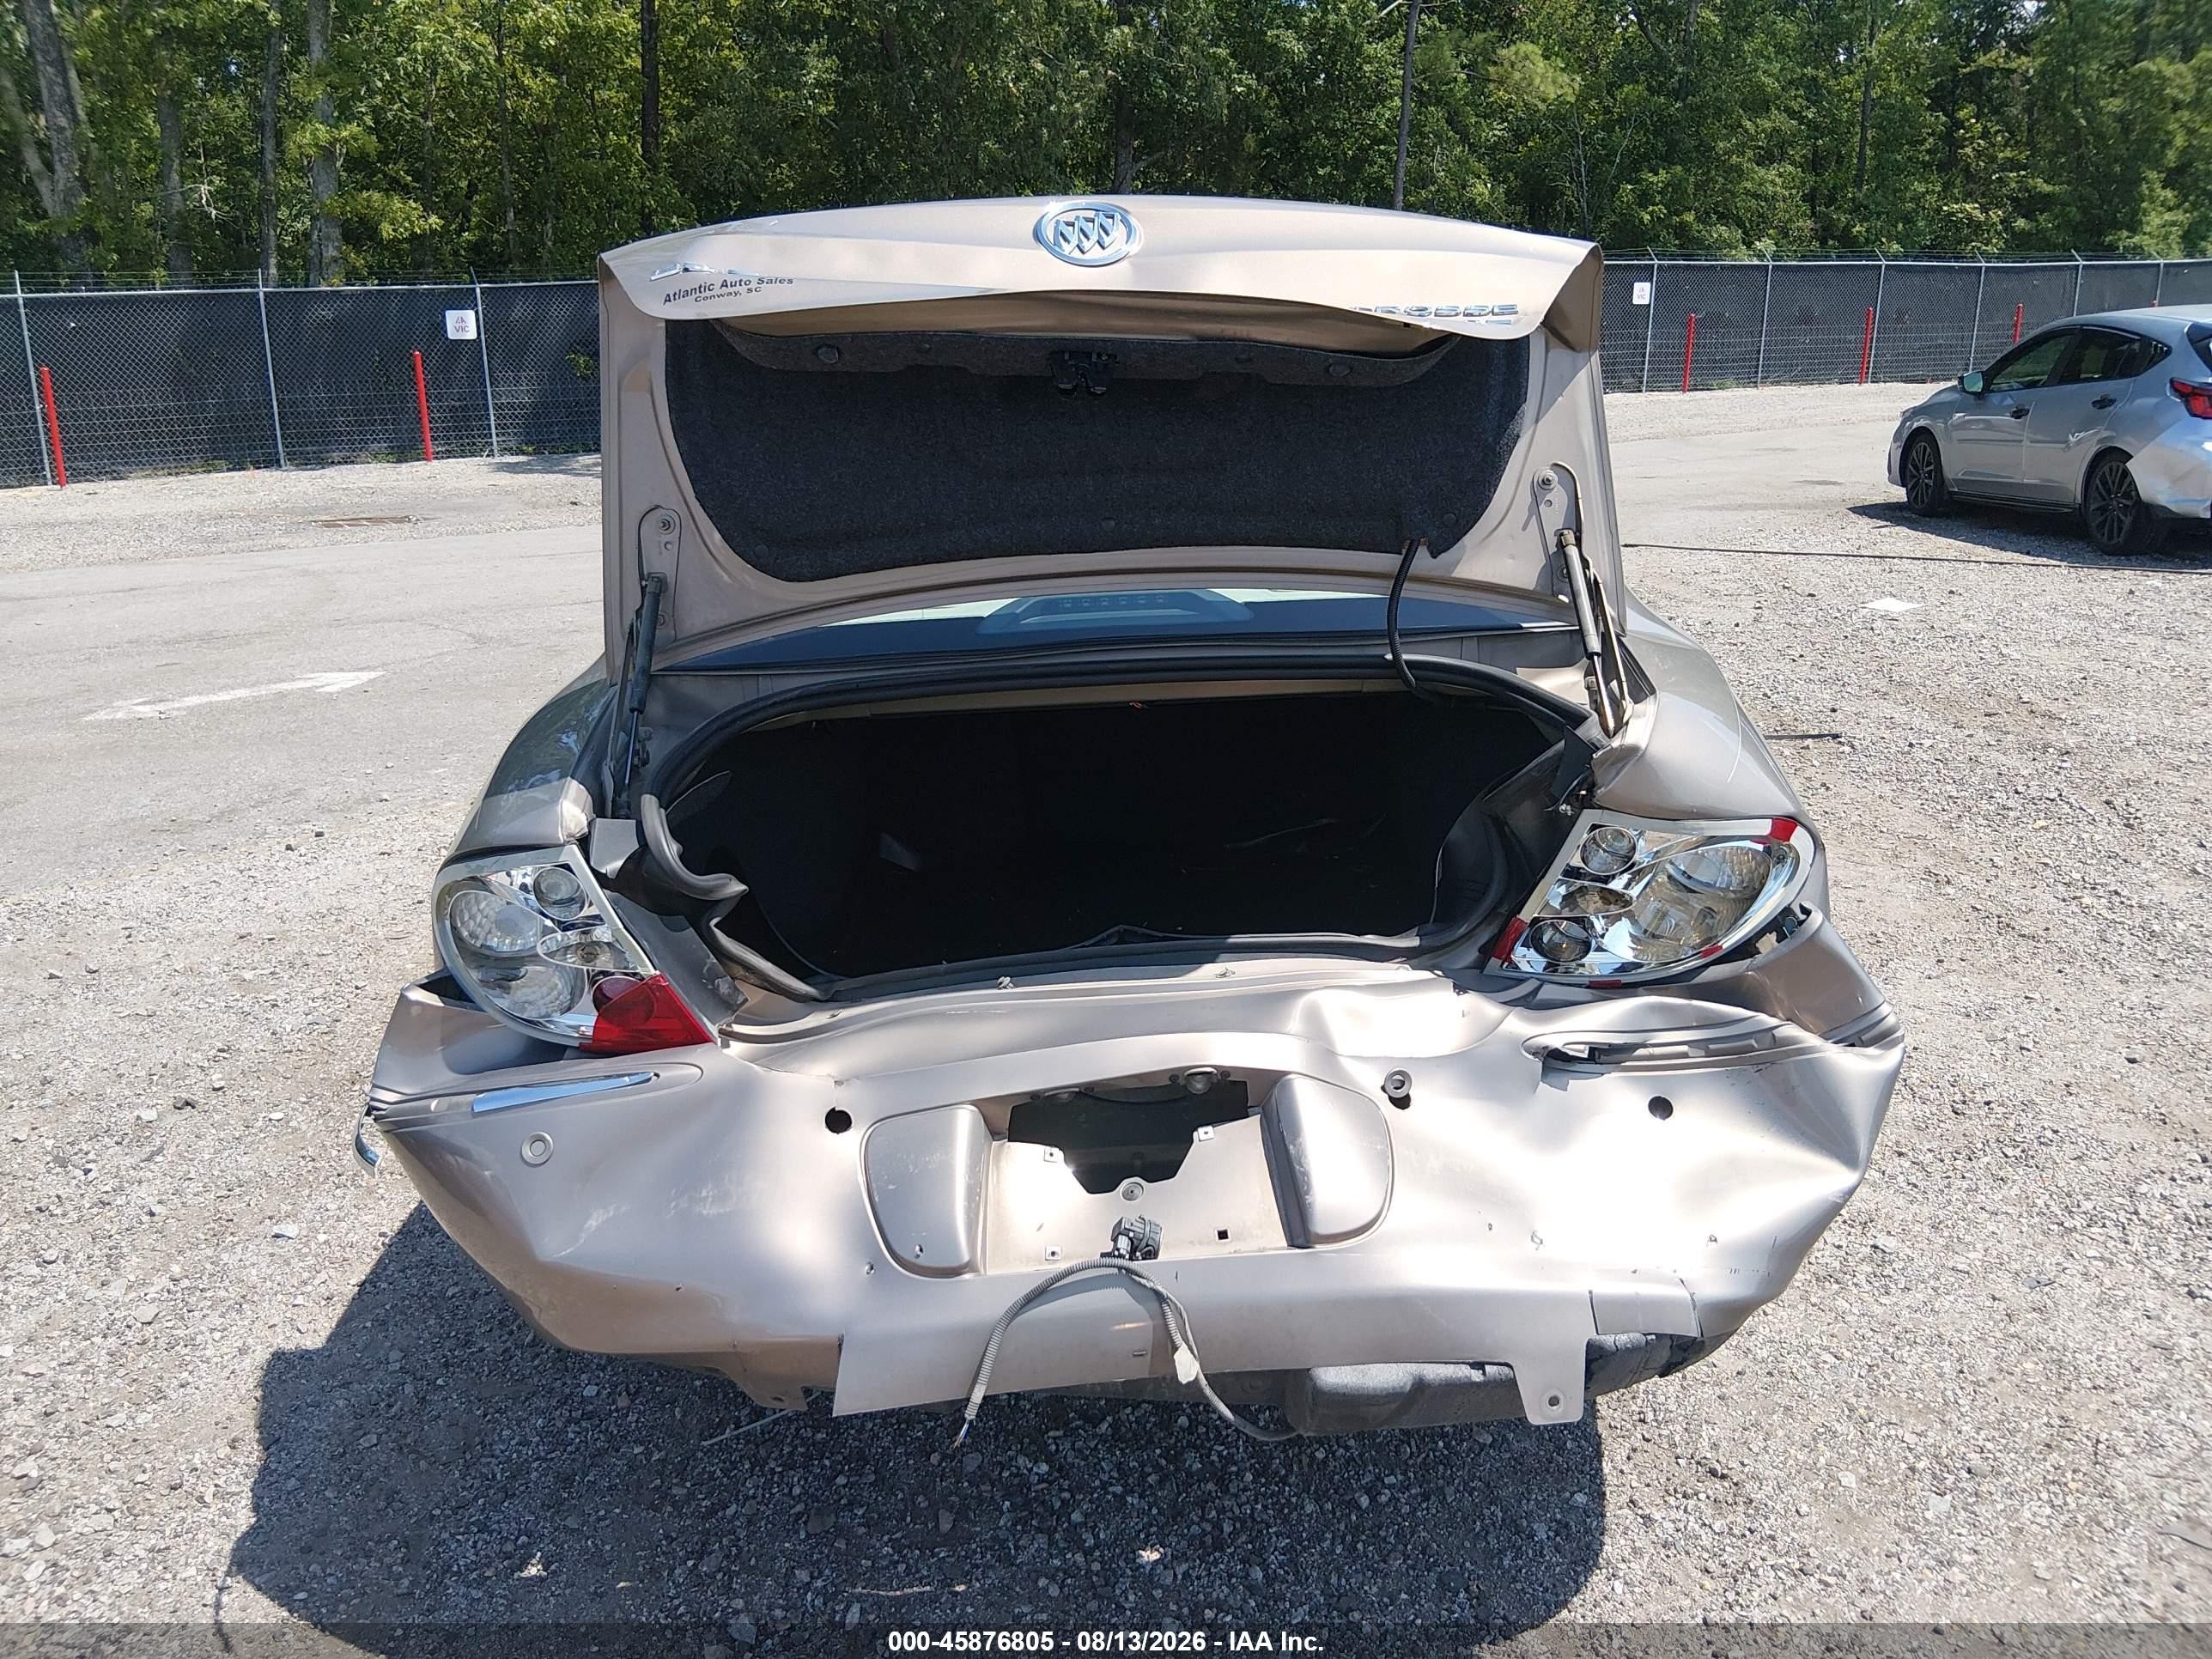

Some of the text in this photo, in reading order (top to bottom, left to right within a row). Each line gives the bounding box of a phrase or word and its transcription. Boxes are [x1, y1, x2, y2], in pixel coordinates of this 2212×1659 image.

[663, 276, 794, 305] Atlantic Auto Sales
[694, 289, 743, 303] Conway,
